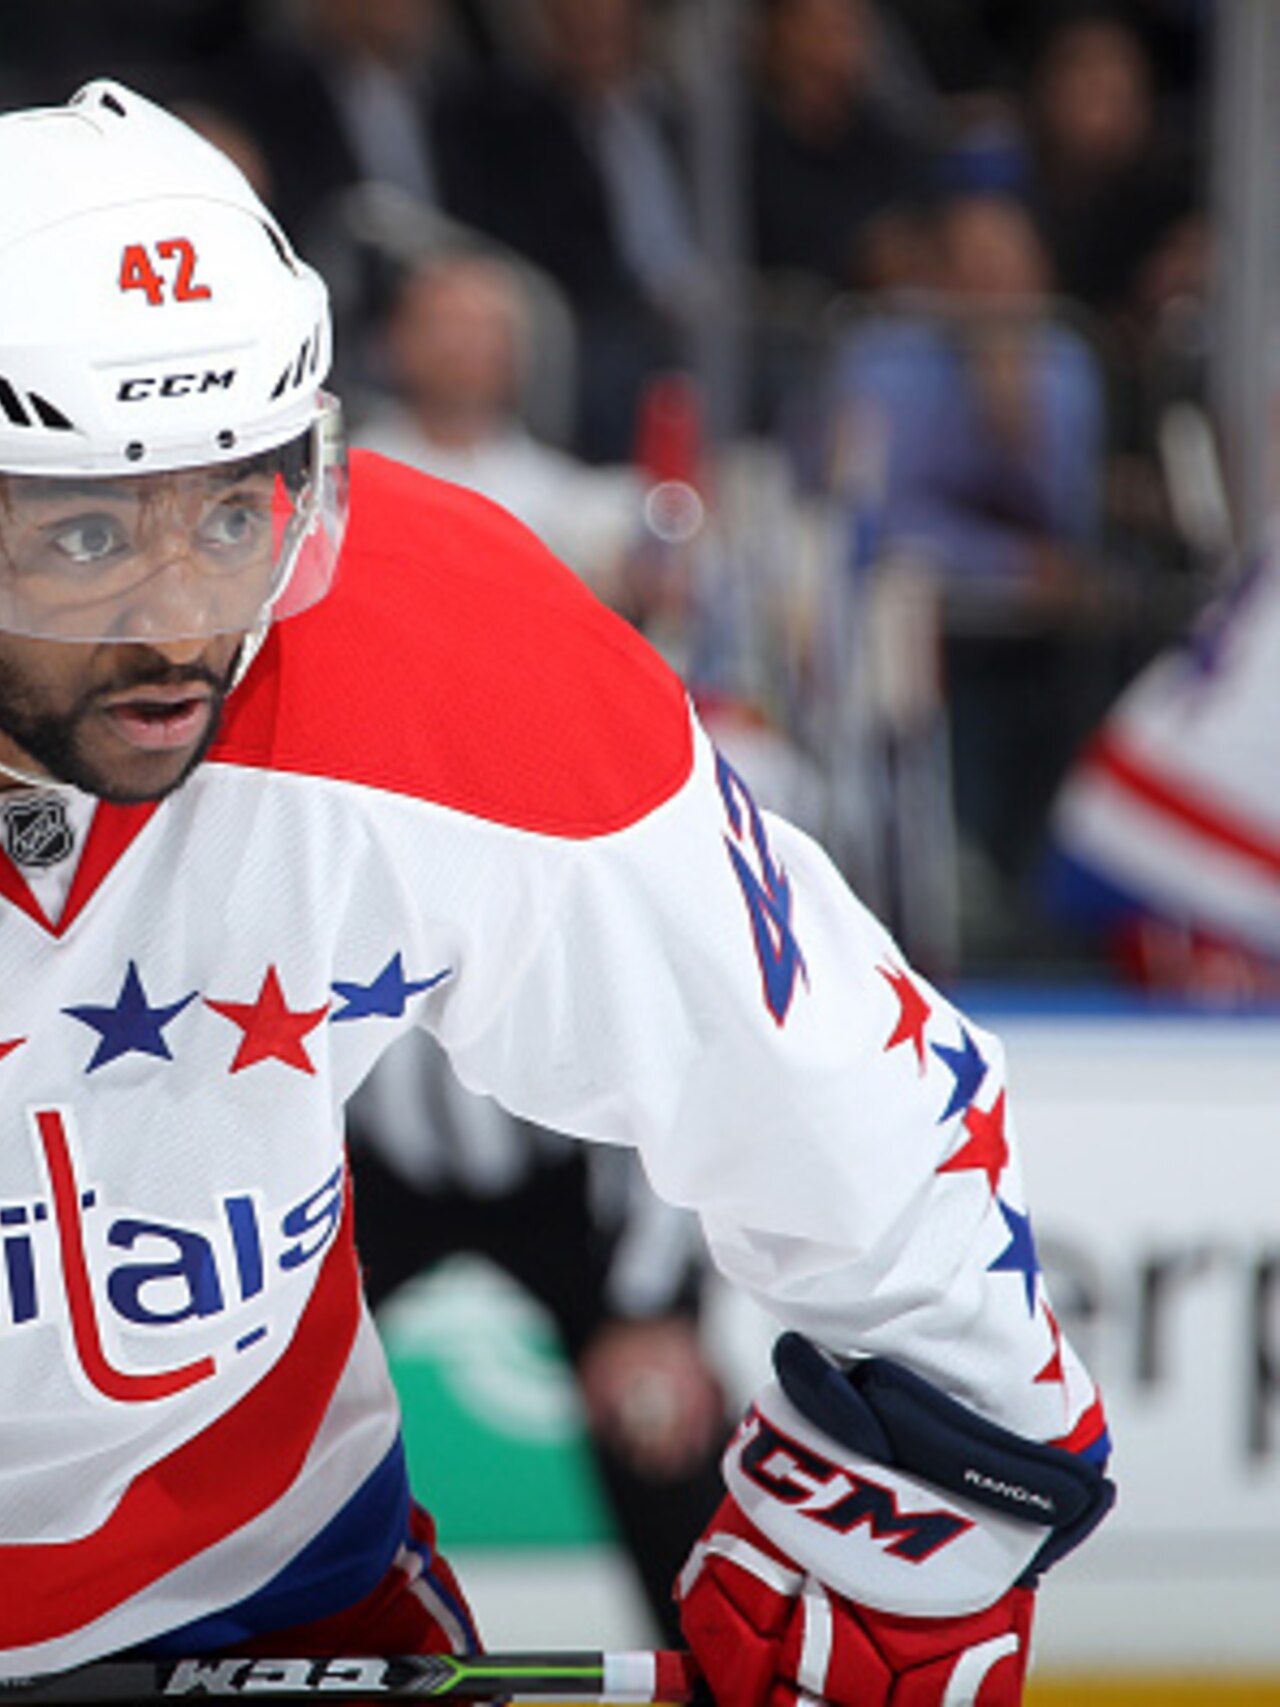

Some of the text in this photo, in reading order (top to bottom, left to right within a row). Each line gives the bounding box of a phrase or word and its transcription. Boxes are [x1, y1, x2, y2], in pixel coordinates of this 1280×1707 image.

[118, 237, 212, 306] 42
[116, 367, 236, 402] CCM
[736, 1402, 976, 1565] CM
[163, 1658, 389, 1695] CCM
